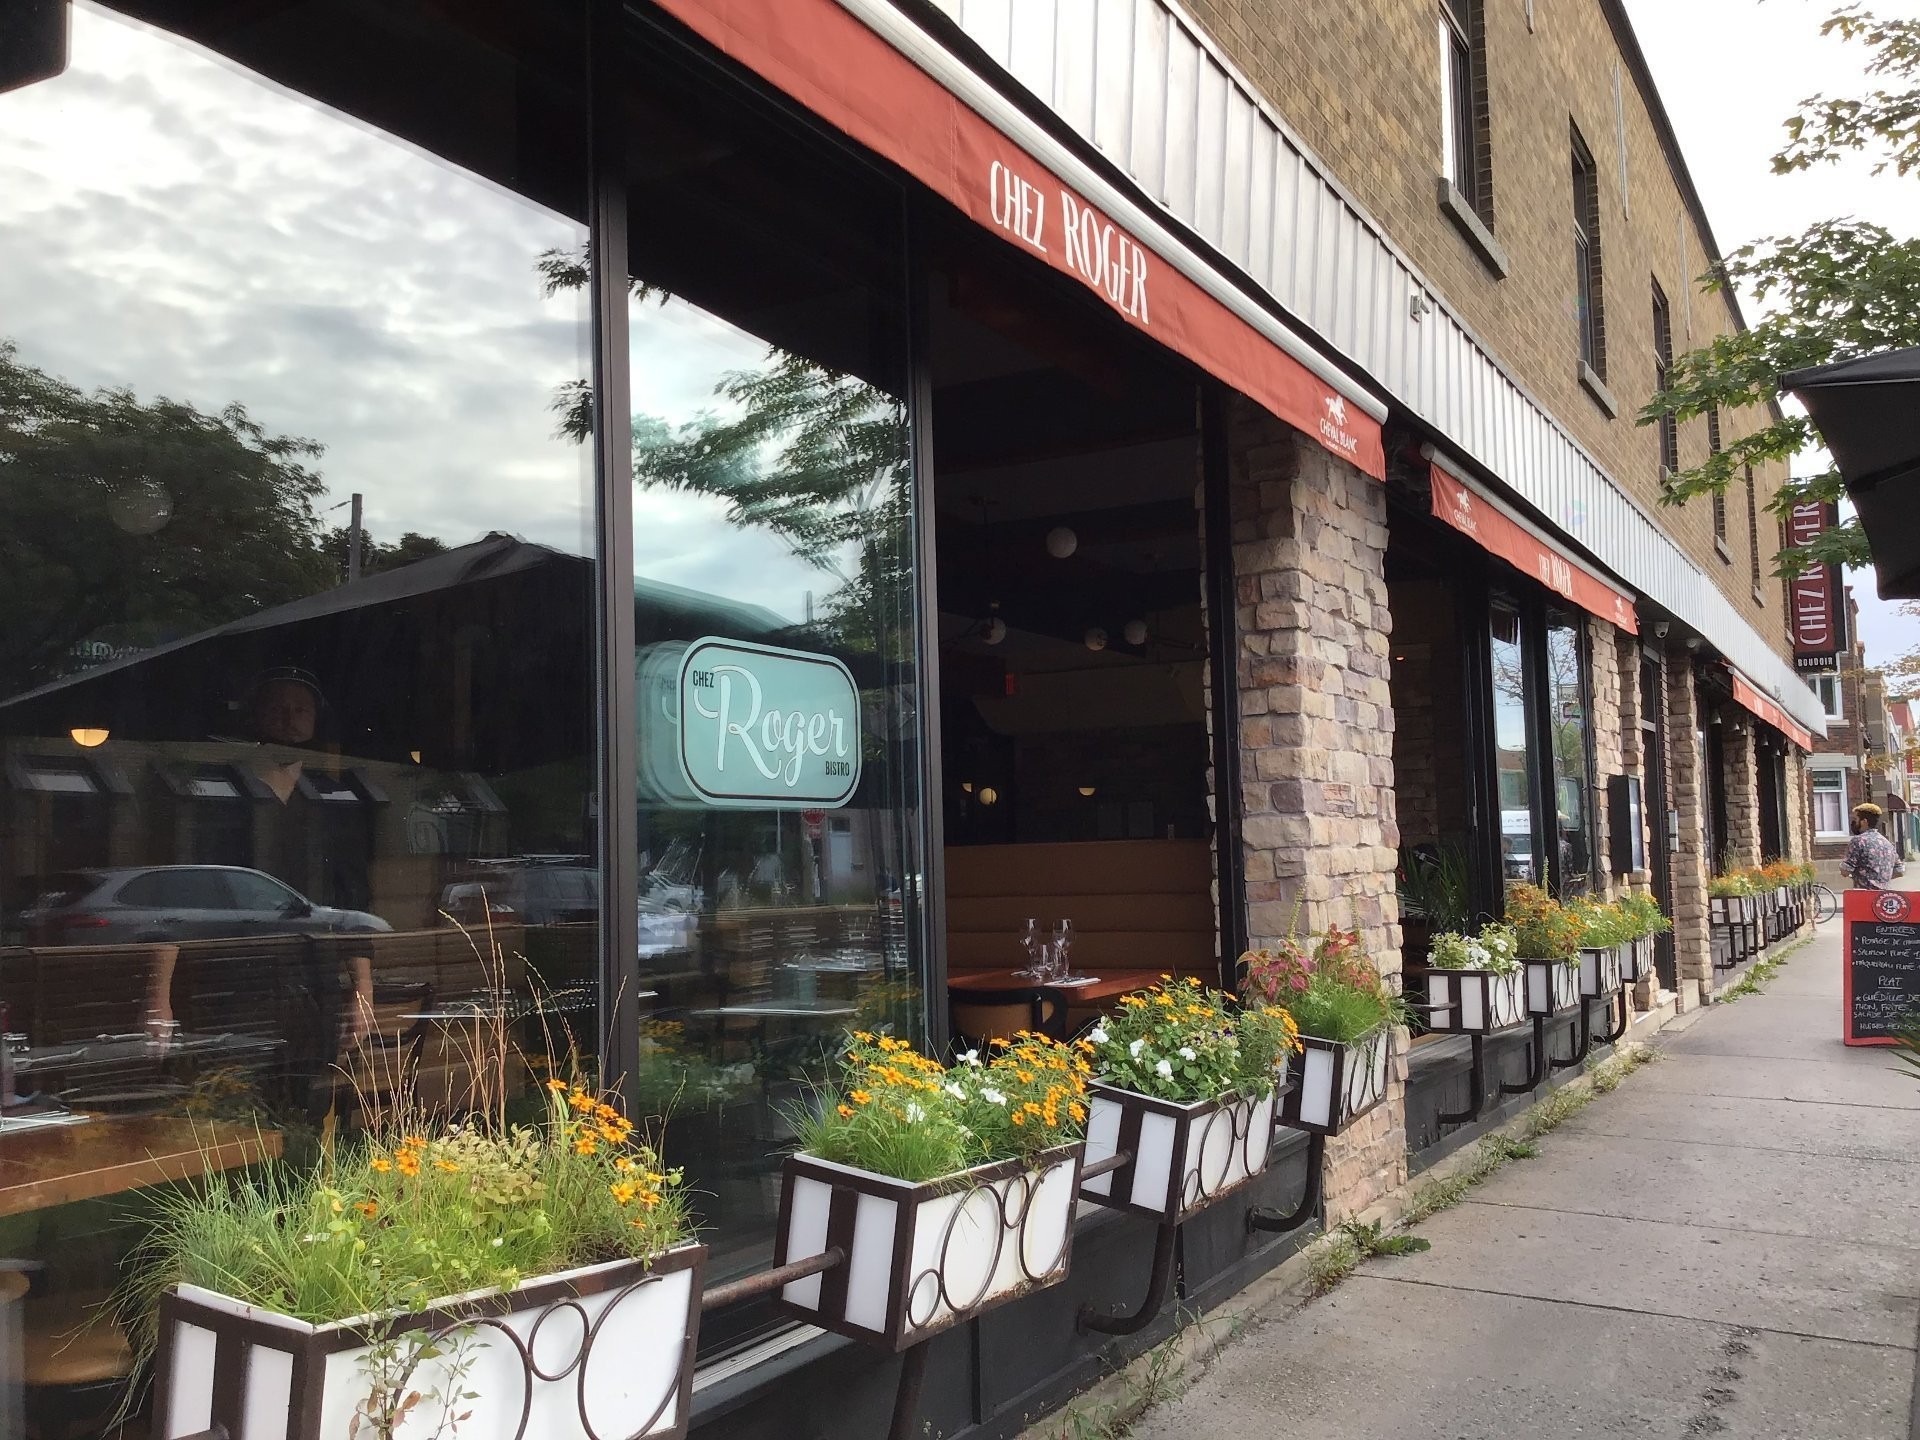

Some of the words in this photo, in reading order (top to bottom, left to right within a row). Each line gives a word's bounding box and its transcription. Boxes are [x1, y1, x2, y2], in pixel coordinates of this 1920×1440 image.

[990, 160, 1047, 253] CHEZ
[1060, 189, 1149, 325] ROGER
[1793, 501, 1823, 581] RGER
[1798, 587, 1827, 645] CHEZ
[692, 670, 715, 689] CHEZ
[1797, 656, 1833, 667] BOUDOIR
[693, 664, 849, 788] Roger
[825, 760, 851, 777] BISTRO
[1878, 975, 1904, 987] PLAT
